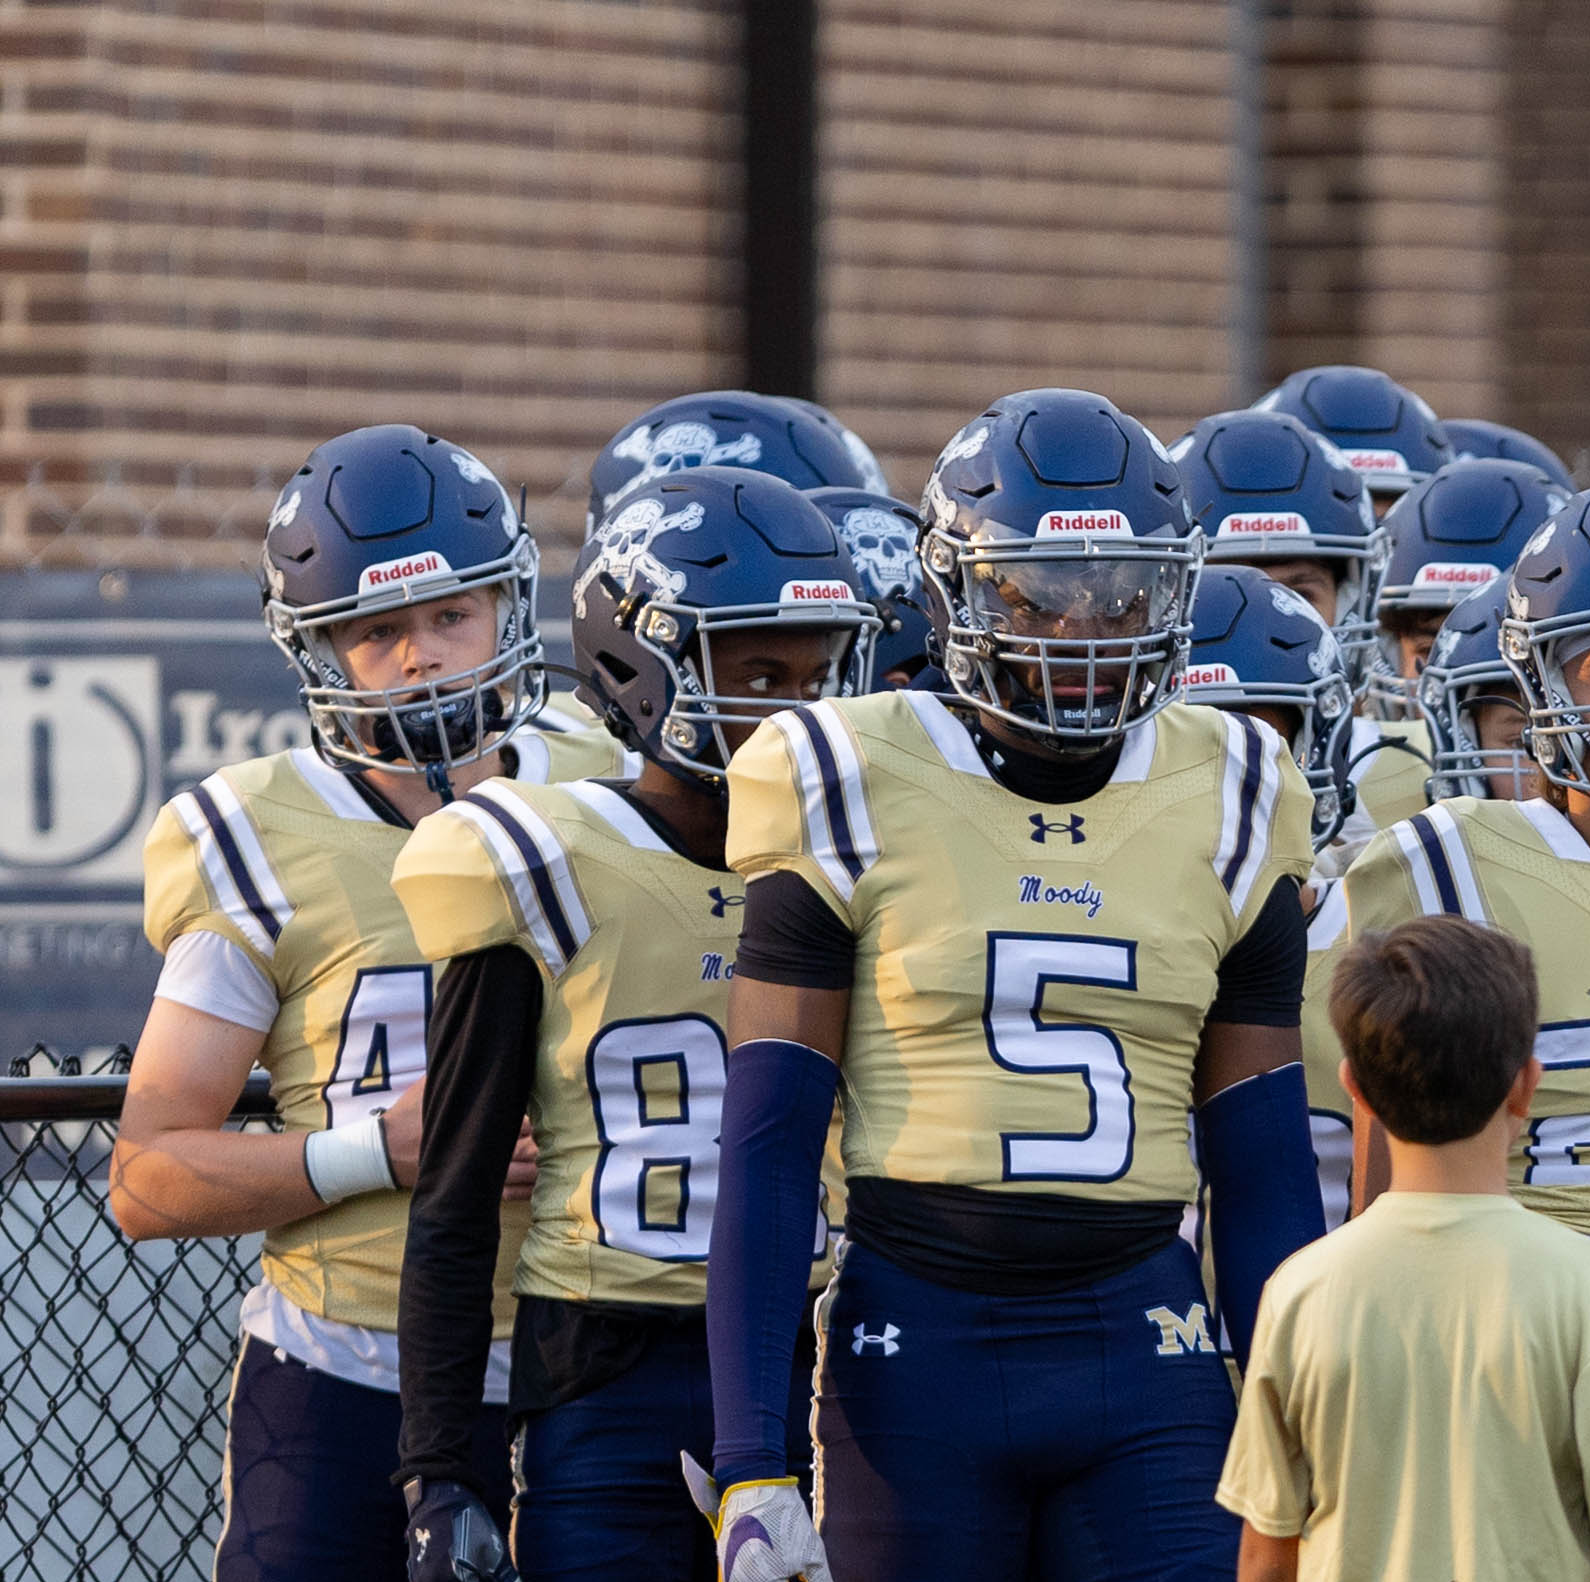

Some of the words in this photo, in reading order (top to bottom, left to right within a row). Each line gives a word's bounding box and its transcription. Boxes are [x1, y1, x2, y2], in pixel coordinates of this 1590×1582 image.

[1350, 456, 1398, 470] ddell
[1049, 514, 1122, 532] Riddell
[1229, 518, 1299, 533] Riddell
[367, 555, 439, 586] Riddell
[1425, 567, 1492, 583] Riddell
[791, 584, 850, 601] Riddell
[166, 691, 310, 770] Iro
[1018, 873, 1104, 919] Moody
[981, 930, 1139, 1182] 5
[586, 1011, 828, 1265] 8
[1145, 1302, 1218, 1356] M
